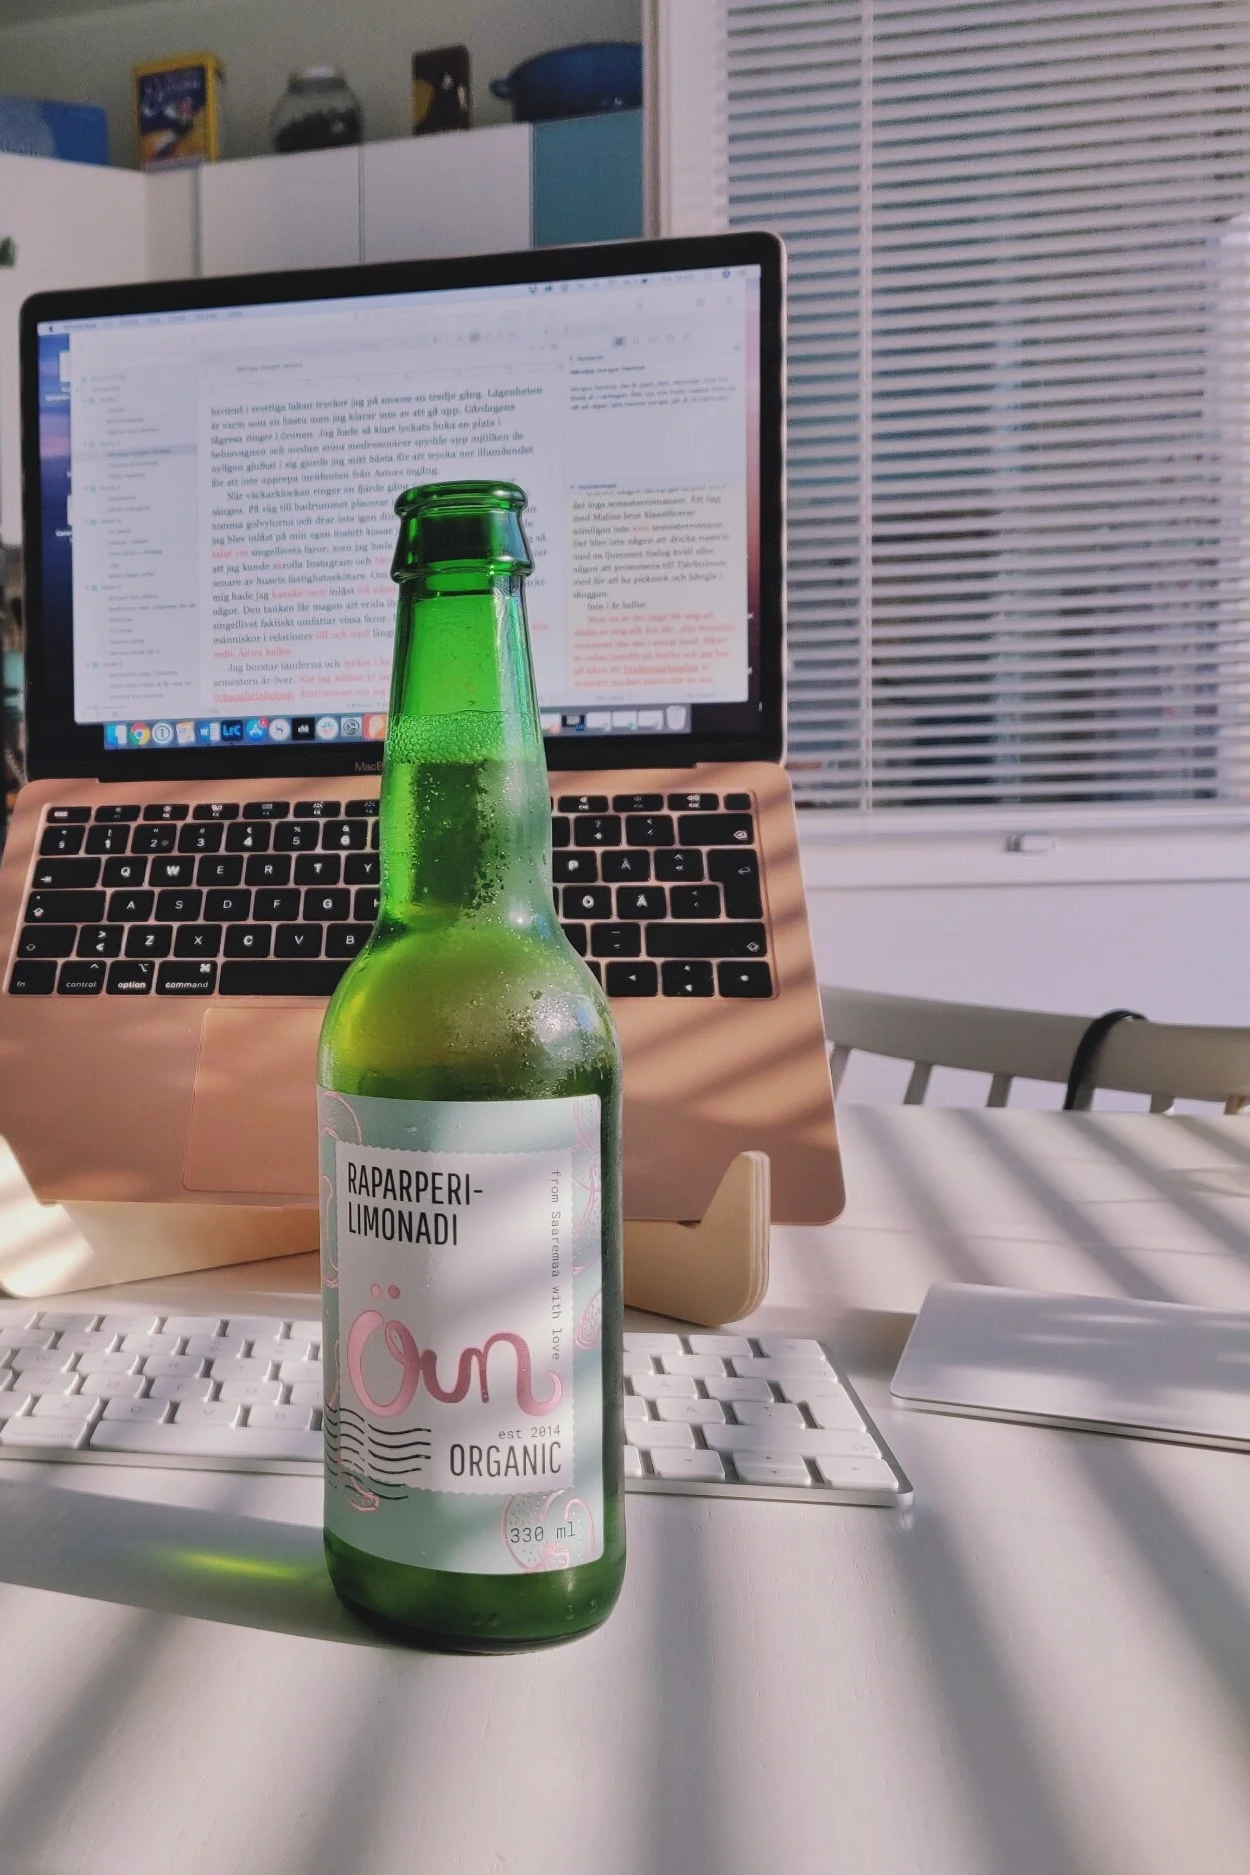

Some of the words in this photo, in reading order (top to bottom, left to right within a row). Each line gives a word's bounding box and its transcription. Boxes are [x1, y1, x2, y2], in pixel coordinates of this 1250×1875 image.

[355, 761, 383, 771] MacB
[66, 980, 97, 988] control
[117, 980, 147, 989] option
[165, 980, 209, 989] command
[347, 1161, 484, 1206] RAPARPERI-
[551, 1169, 561, 1204] from
[348, 1201, 458, 1246] LIMONADI
[551, 1211, 561, 1278] Saaremaa
[551, 1285, 563, 1319] with
[551, 1326, 563, 1361] love
[498, 1428, 523, 1440] est
[530, 1424, 561, 1438] 2014
[449, 1441, 562, 1478] ORGANIC
[509, 1525, 544, 1544] 330
[555, 1521, 576, 1540] ml
